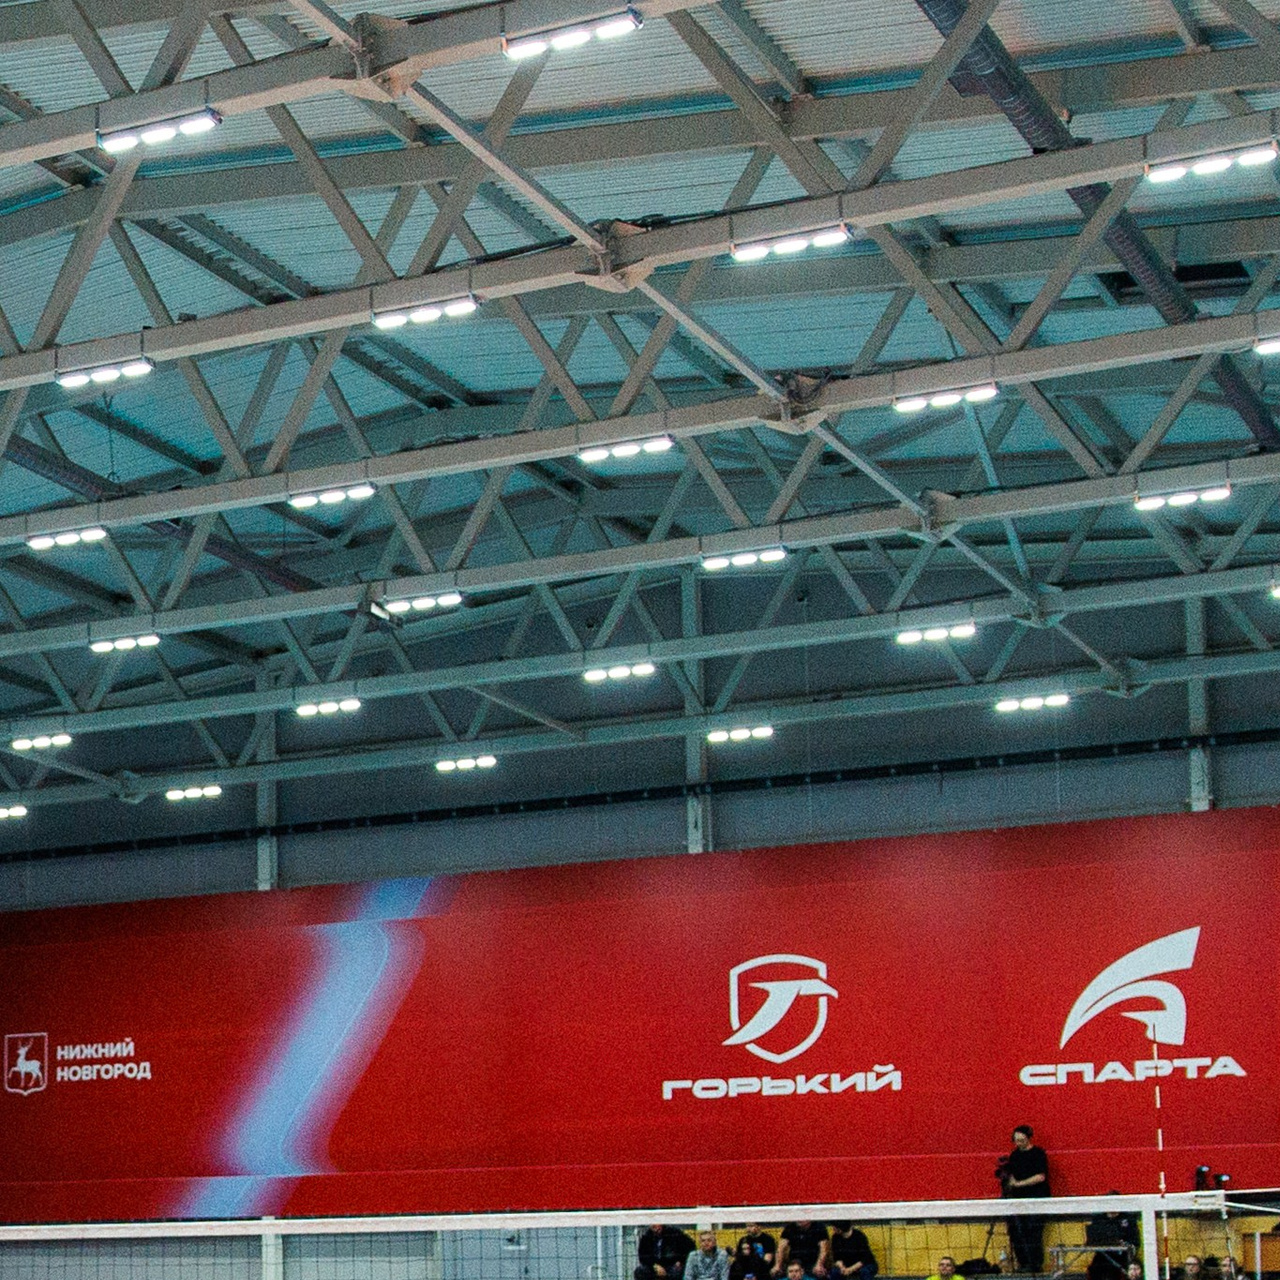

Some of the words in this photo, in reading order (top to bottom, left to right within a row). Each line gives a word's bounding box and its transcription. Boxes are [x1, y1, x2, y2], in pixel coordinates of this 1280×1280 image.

[56, 1037, 135, 1060] НИЖНИЙ
[56, 1062, 152, 1082] НОВГОРОД
[662, 1064, 902, 1100] ГОРЬКИЙ
[1020, 1056, 1247, 1086] СПАРТА
